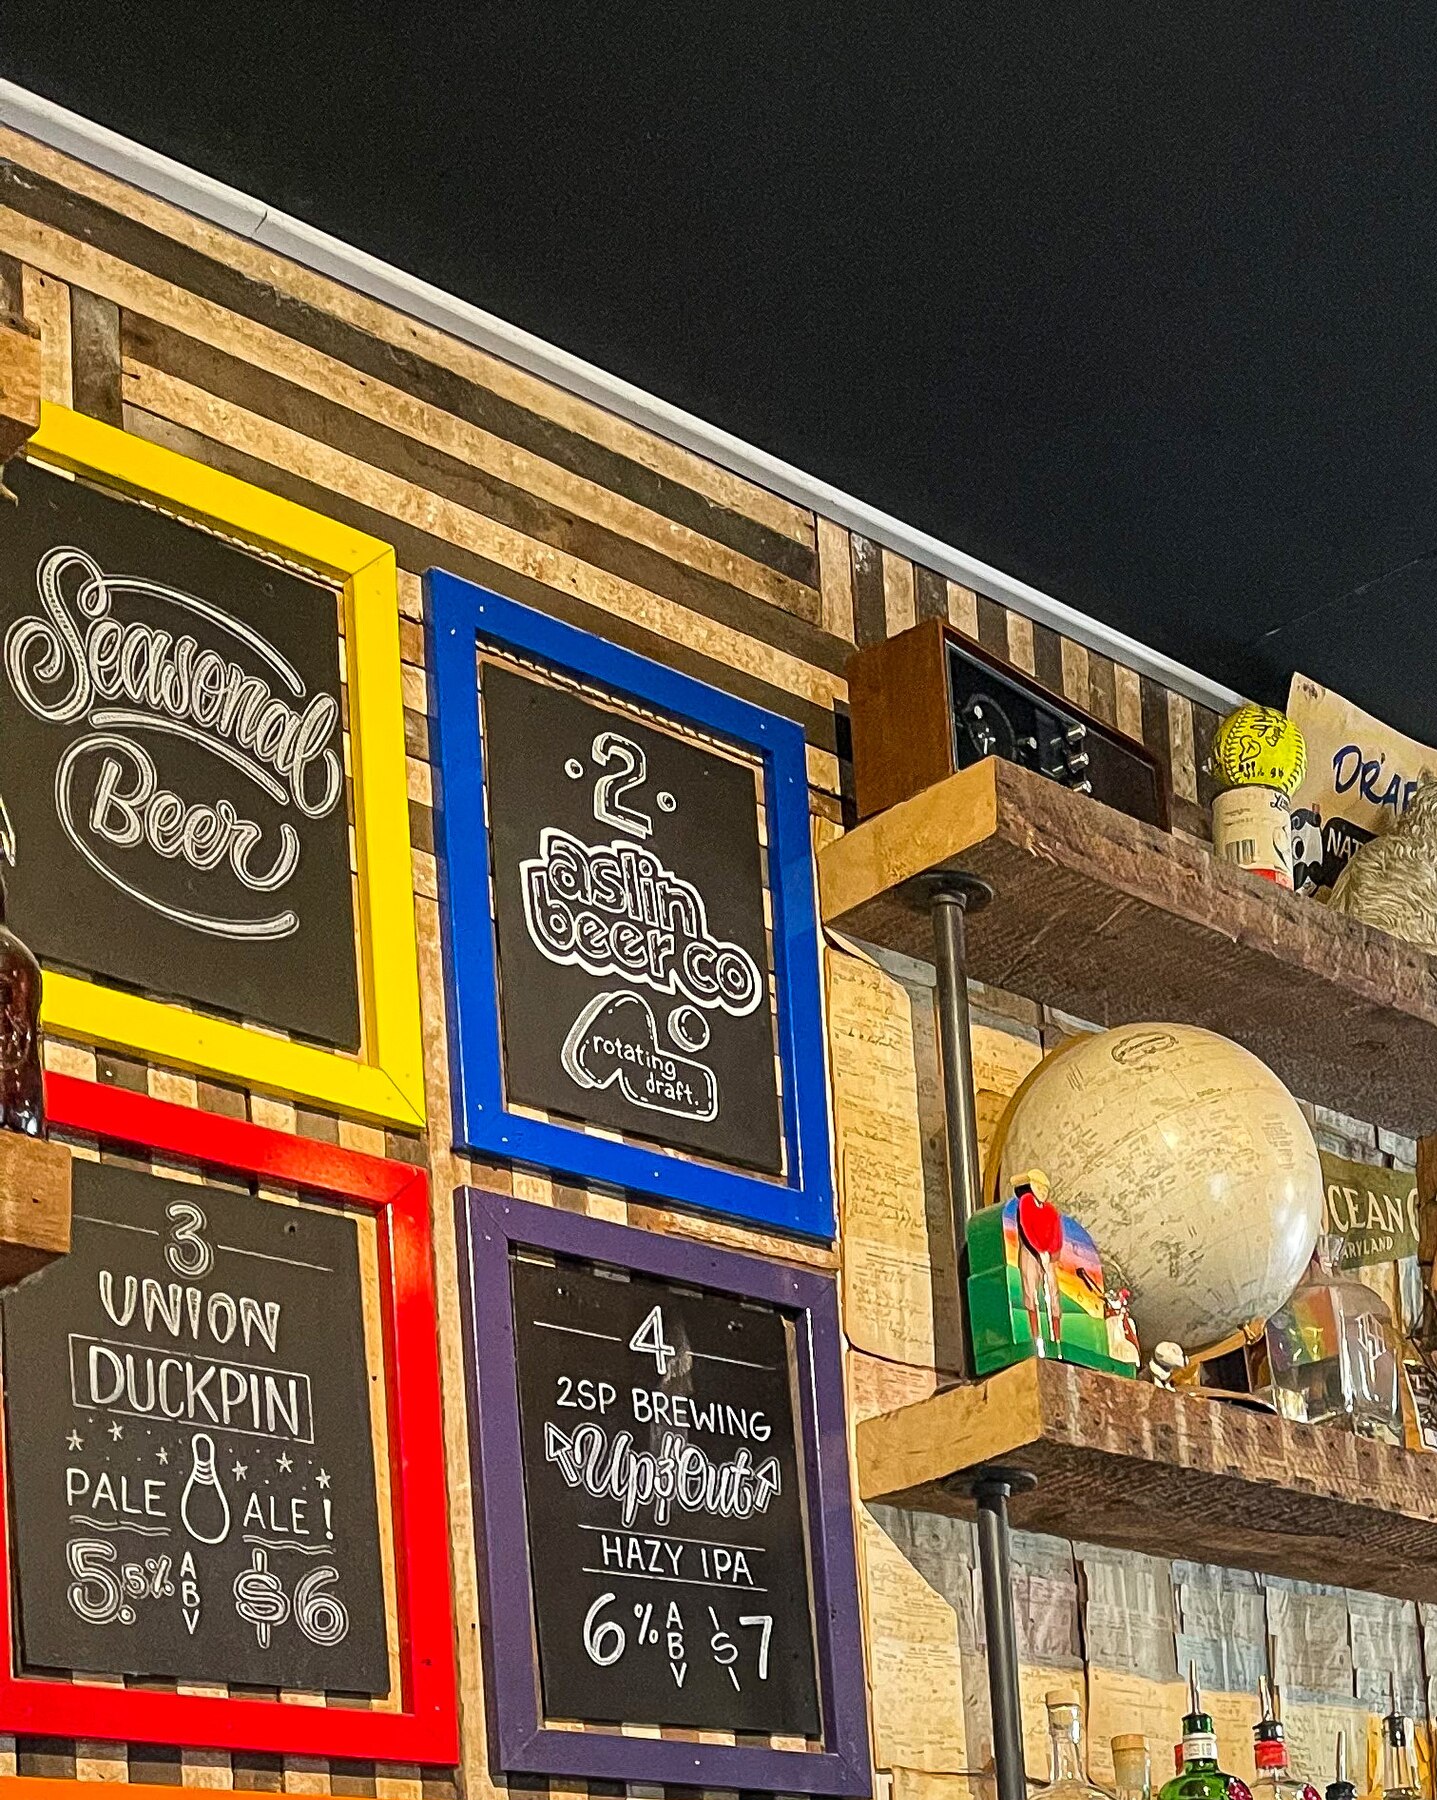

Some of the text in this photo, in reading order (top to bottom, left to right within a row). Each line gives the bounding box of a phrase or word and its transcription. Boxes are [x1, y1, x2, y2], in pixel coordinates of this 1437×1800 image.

[4, 546, 340, 818] Seasonal
[591, 731, 653, 837] 2
[1332, 745, 1418, 817] DRAF
[56, 733, 300, 940] Beer
[1327, 826, 1364, 858] NAT
[546, 841, 704, 936] aslin
[534, 870, 756, 1001] beer co
[591, 1033, 677, 1081] rotating
[164, 1200, 212, 1279] 3
[1327, 1184, 1404, 1233] CEAN
[1340, 1236, 1394, 1260] ARYLAND
[99, 1270, 280, 1353] UNION
[628, 1305, 676, 1375] 4
[88, 1344, 299, 1436] DUCKPIN
[556, 1376, 772, 1442] 2SP BREWING
[65, 1467, 166, 1518] PALE
[233, 1547, 349, 1648] $6
[601, 1534, 754, 1586] HAZY IPA
[583, 1592, 658, 1666] 6%
[707, 1606, 774, 1691] $7
